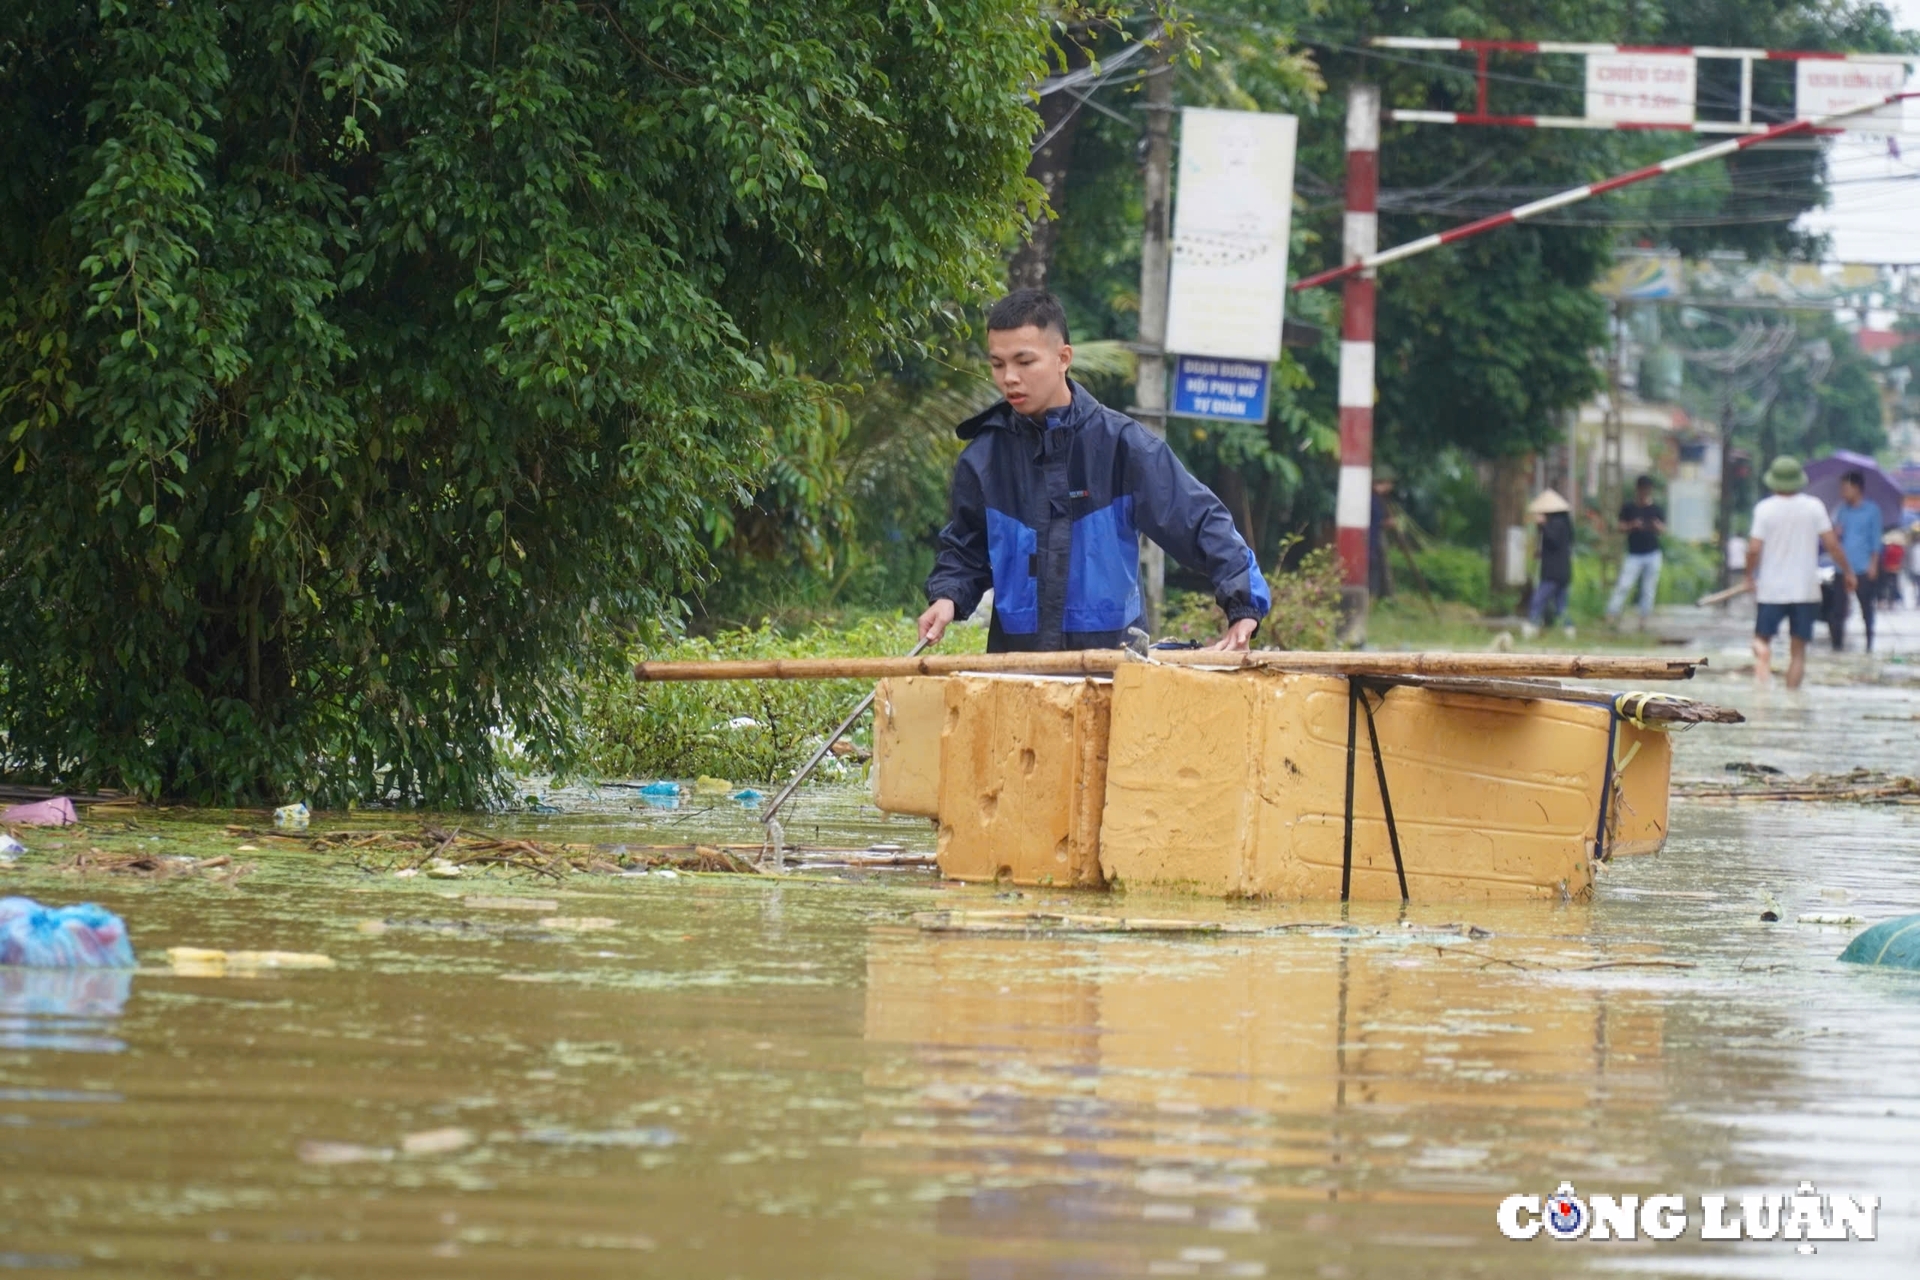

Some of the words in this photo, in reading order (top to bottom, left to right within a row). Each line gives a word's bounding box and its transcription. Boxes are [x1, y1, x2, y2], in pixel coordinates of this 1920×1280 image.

[1186, 376, 1208, 396] HỘI
[1209, 380, 1236, 398] PHỤ
[1237, 381, 1259, 399] NỮ
[1194, 396, 1211, 414] TỰ
